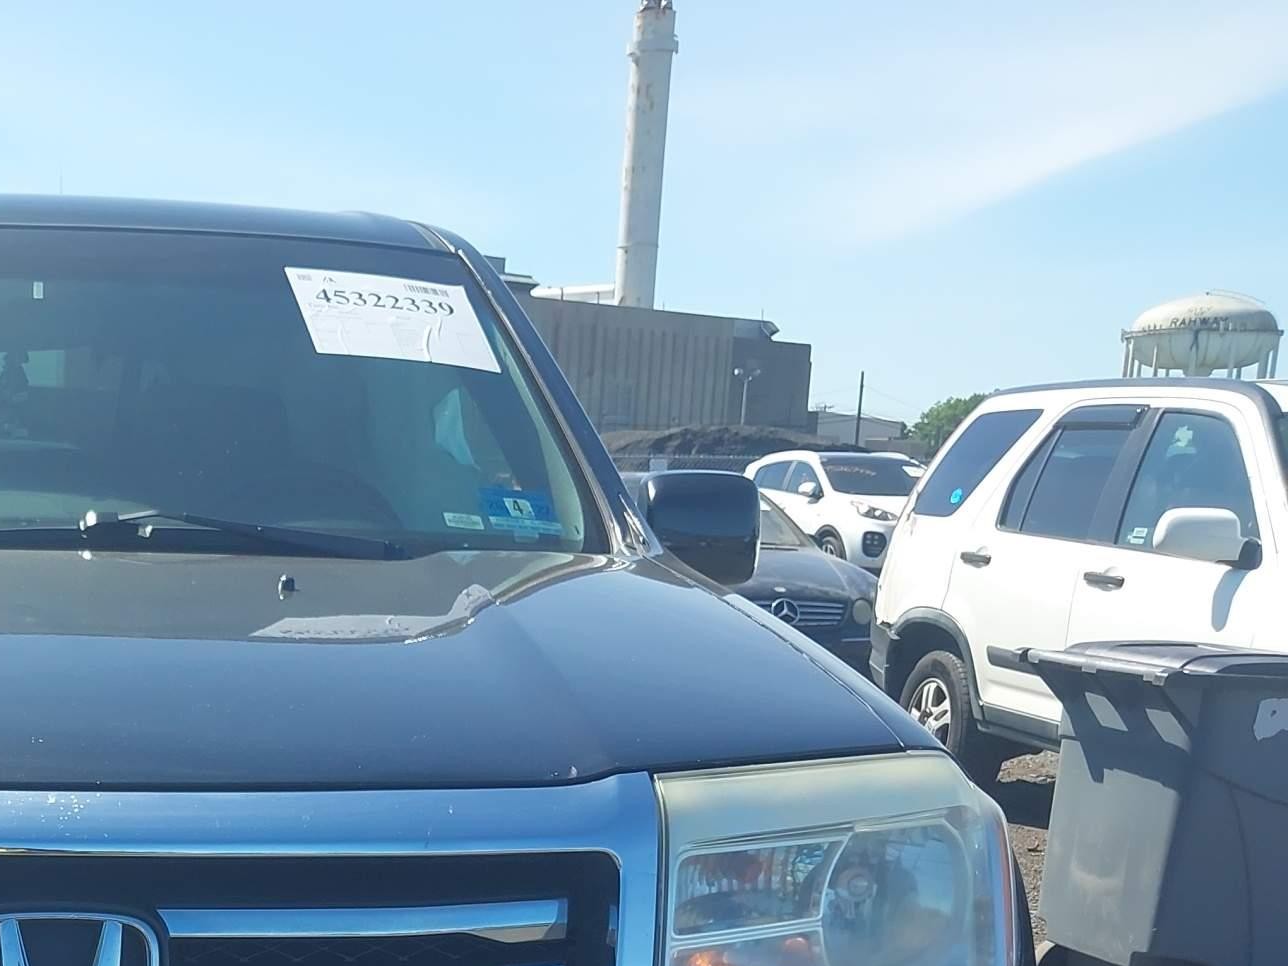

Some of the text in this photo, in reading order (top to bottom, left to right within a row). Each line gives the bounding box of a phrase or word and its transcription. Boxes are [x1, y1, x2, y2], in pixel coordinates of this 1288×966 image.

[315, 288, 455, 316] 45322339
[1170, 317, 1229, 328] RAHWAY
[512, 499, 524, 515] 4
